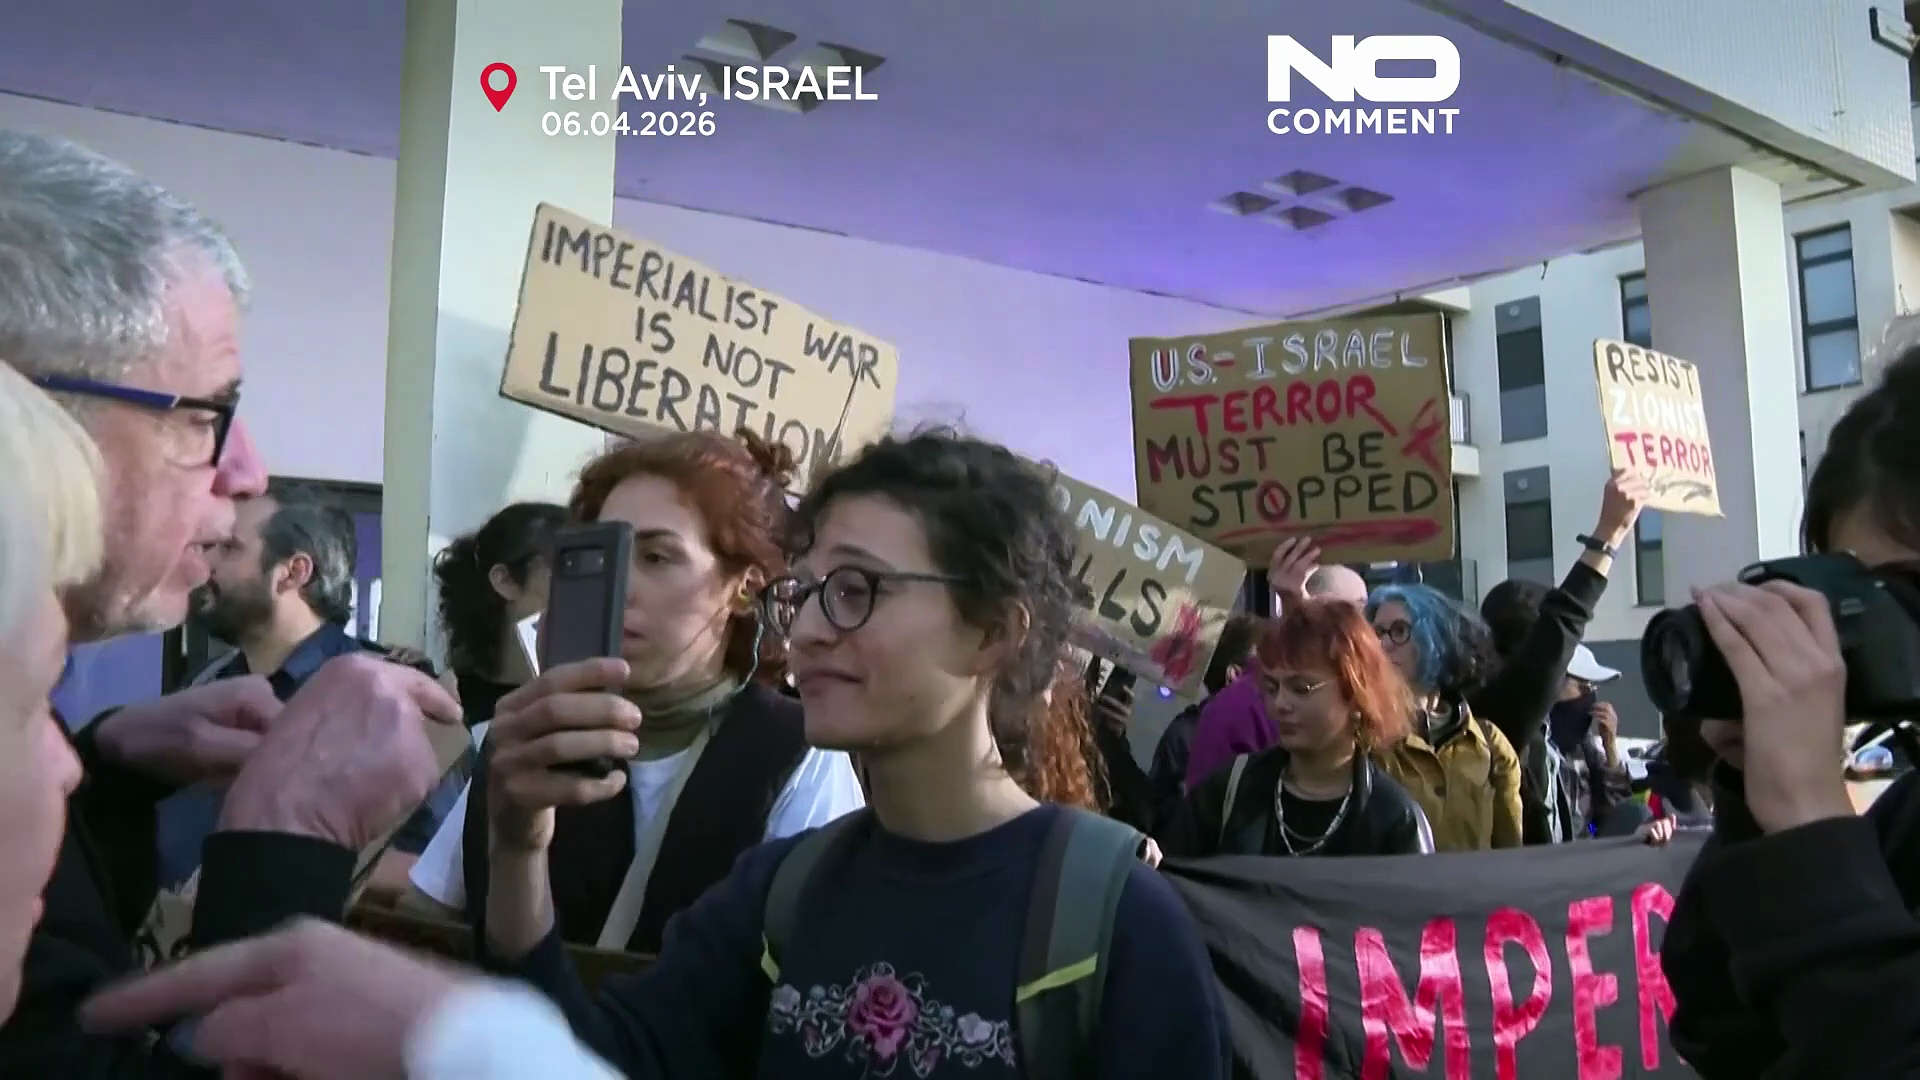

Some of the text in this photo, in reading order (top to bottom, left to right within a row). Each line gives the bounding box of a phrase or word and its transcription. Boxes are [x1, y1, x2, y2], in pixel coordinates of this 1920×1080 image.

[541, 220, 882, 390] IMPERIALIST WAR
[634, 306, 796, 400] IS NOT
[1605, 342, 1695, 398] RESIST
[1149, 373, 1399, 437] TERROR
[1145, 431, 1385, 483] MUST BE
[1613, 431, 1714, 480] TERROR
[1190, 470, 1439, 528] STOPPED
[1053, 482, 1205, 585] NISM
[1070, 551, 1168, 639] LLS
